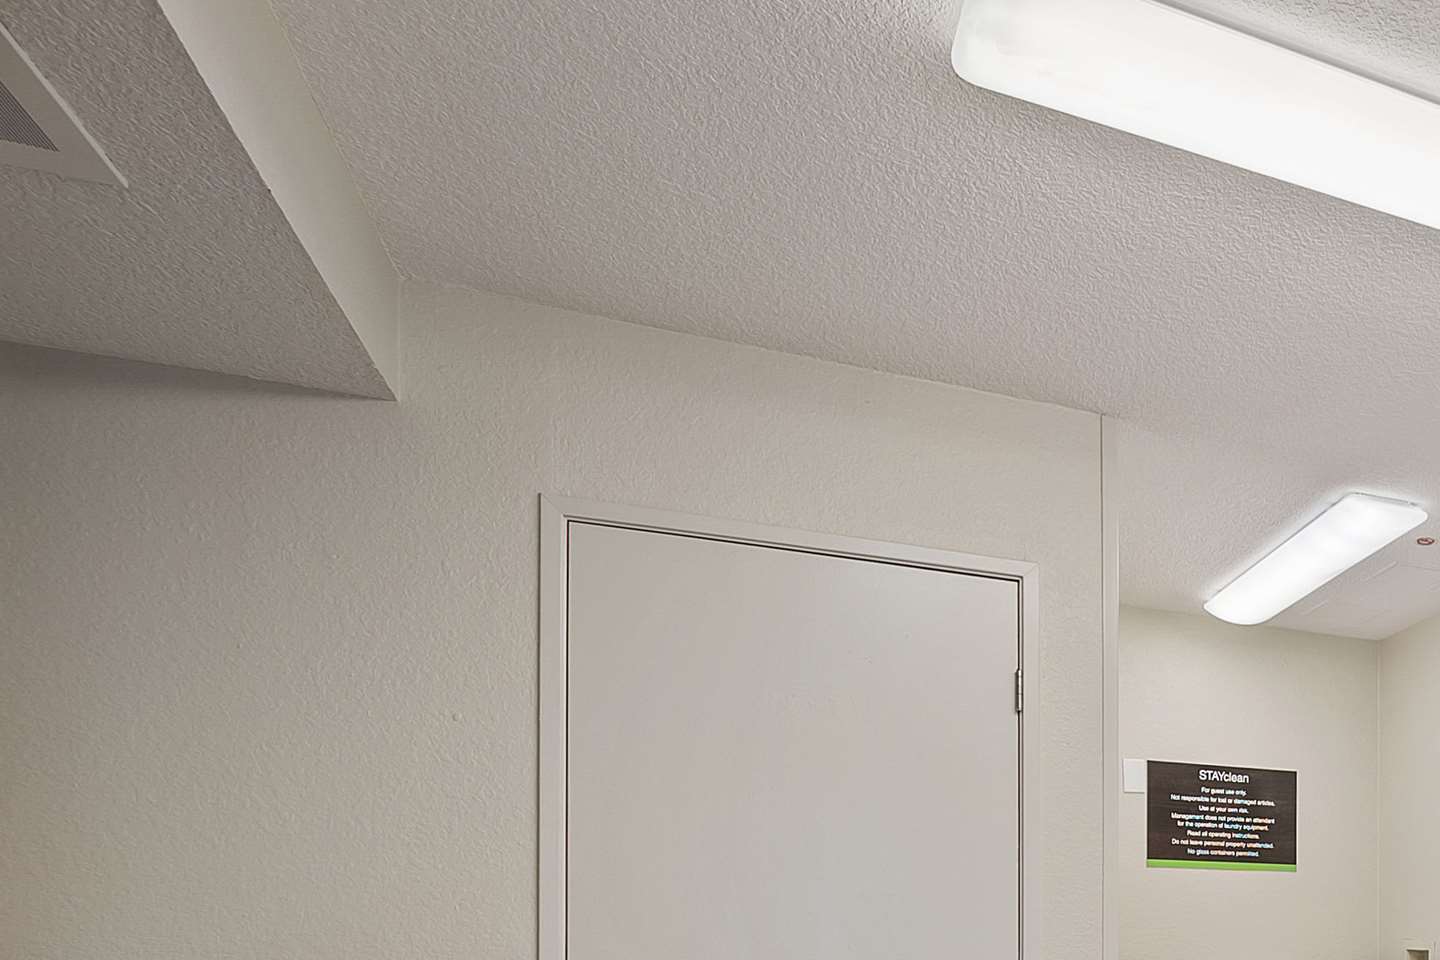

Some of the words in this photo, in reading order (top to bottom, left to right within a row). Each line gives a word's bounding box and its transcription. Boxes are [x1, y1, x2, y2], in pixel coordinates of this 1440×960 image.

[1199, 769, 1249, 783] STAYclean
[1211, 788, 1224, 796] guest
[1181, 795, 1209, 803] responsible
[1234, 798, 1256, 806] damaged
[1171, 812, 1204, 820] Management
[1225, 841, 1246, 849] property
